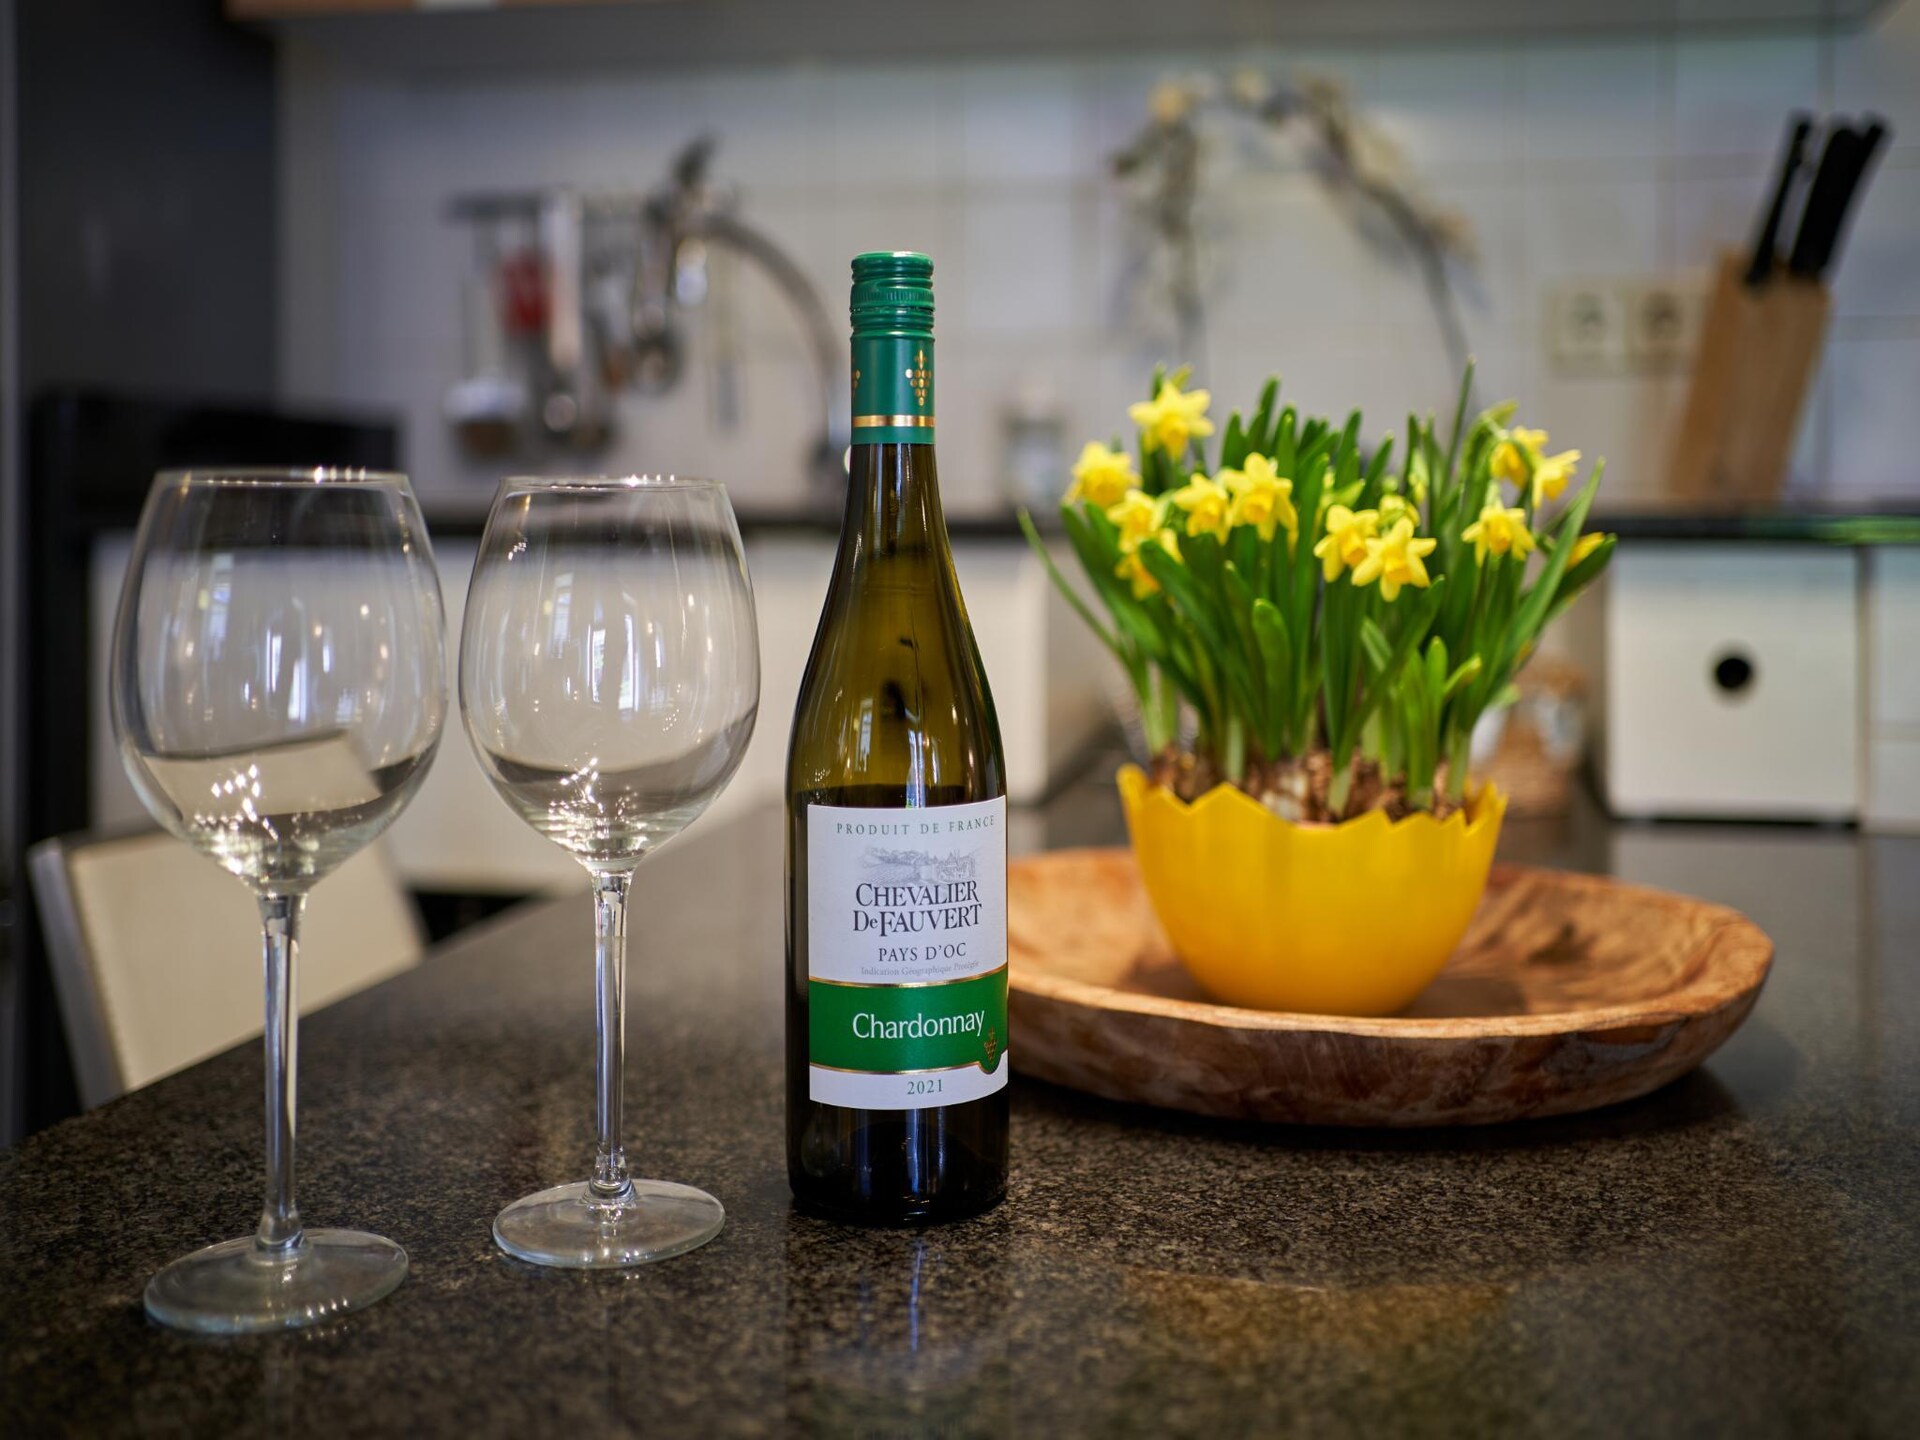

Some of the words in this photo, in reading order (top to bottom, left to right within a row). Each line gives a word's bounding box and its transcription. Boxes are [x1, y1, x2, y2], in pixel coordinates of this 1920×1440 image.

[837, 822, 910, 836] PRODUIT
[920, 823, 940, 834] DE
[949, 815, 995, 832] FRANCE
[856, 880, 980, 907] CHEVALIER
[878, 947, 918, 962] PAYS
[861, 966, 900, 976] Indication
[852, 1010, 985, 1040] Chardonnay
[907, 1079, 943, 1095] 2021
